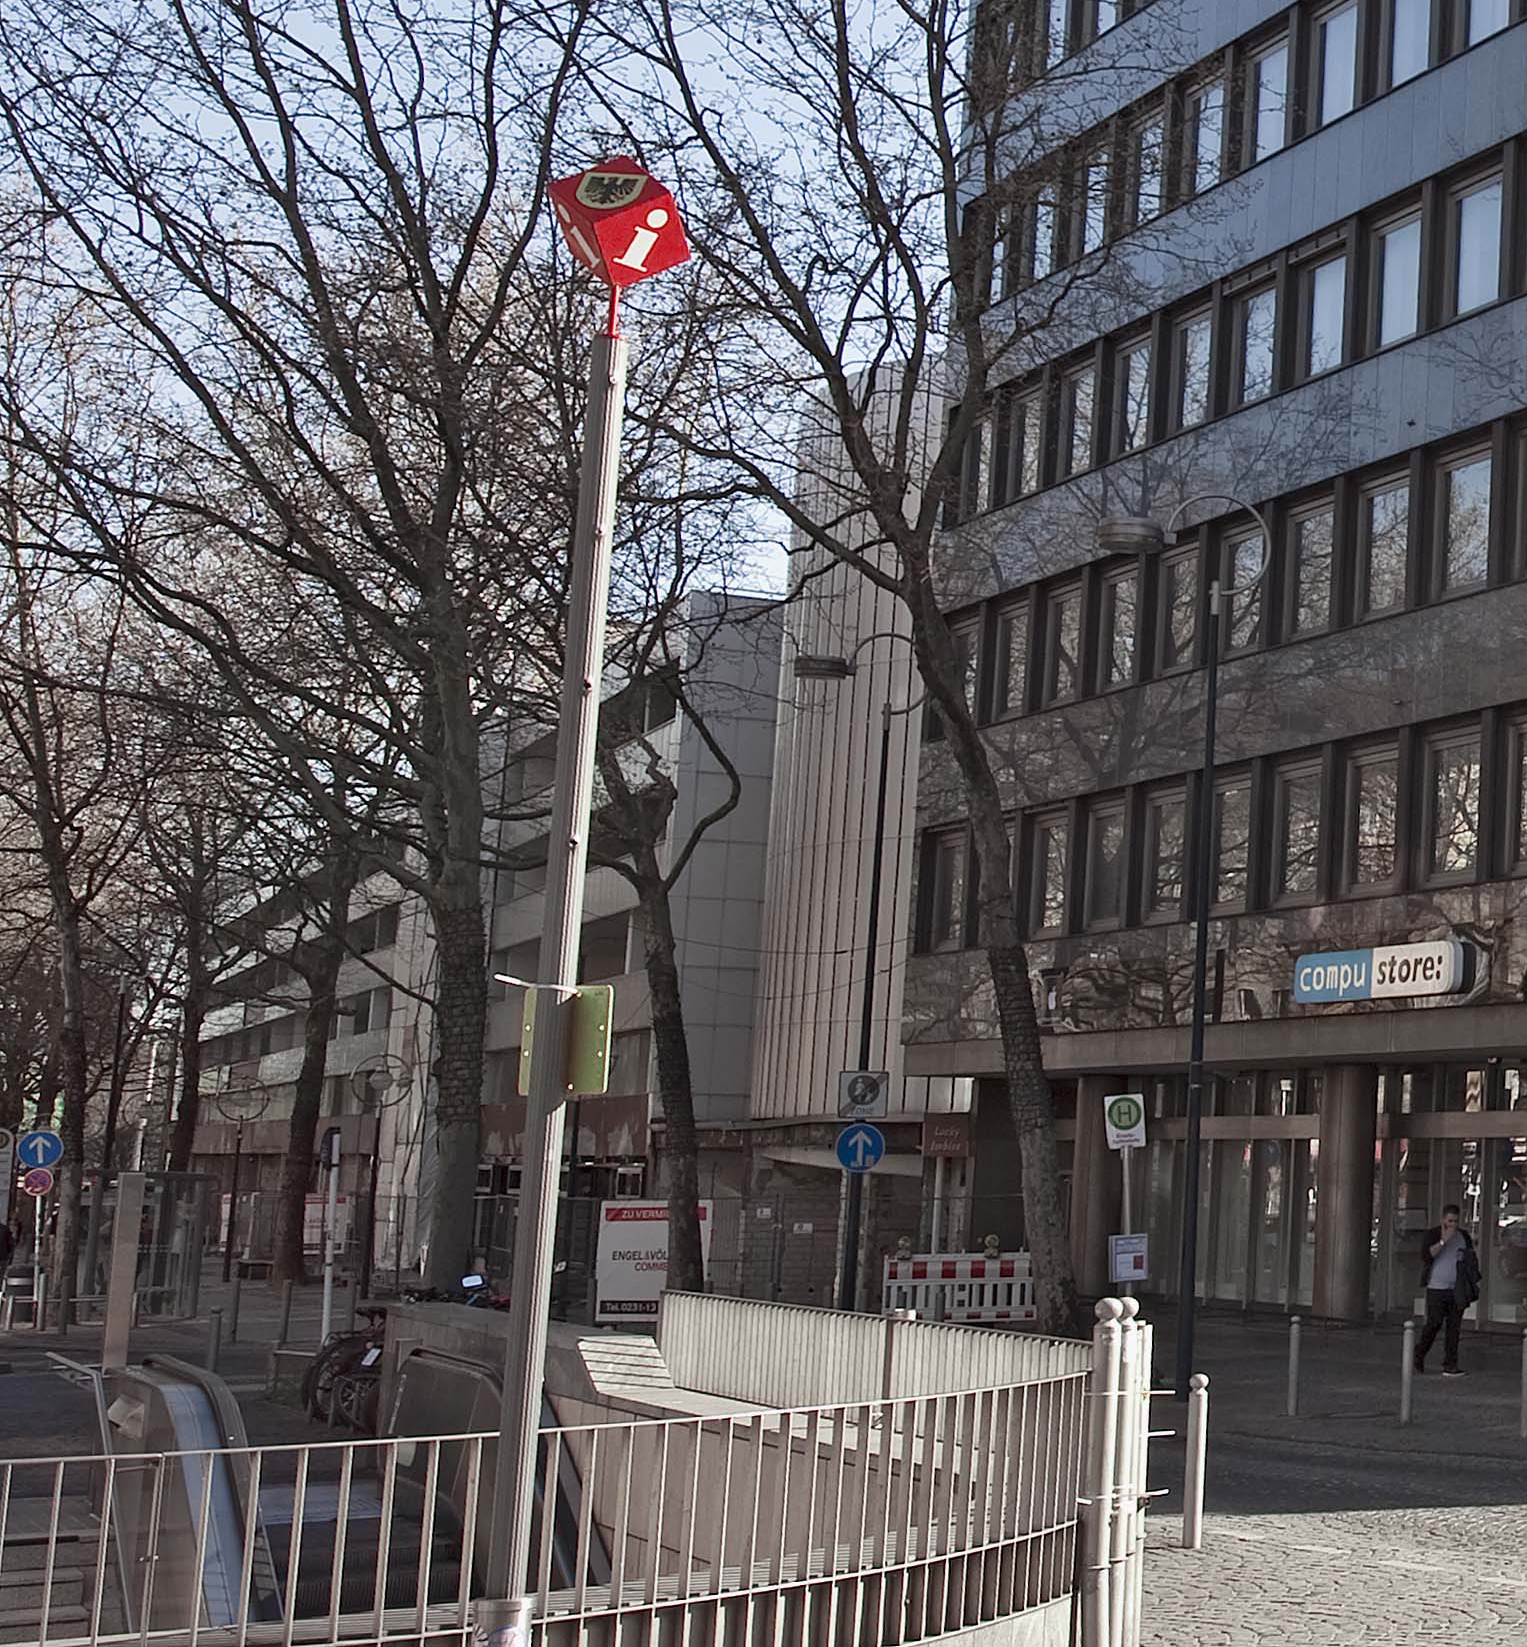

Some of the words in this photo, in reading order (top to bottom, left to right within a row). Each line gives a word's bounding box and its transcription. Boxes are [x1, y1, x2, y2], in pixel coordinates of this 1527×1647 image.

[613, 209, 669, 273] i
[1300, 962, 1366, 996] compu
[1377, 955, 1443, 985] store:
[1118, 1104, 1132, 1123] H
